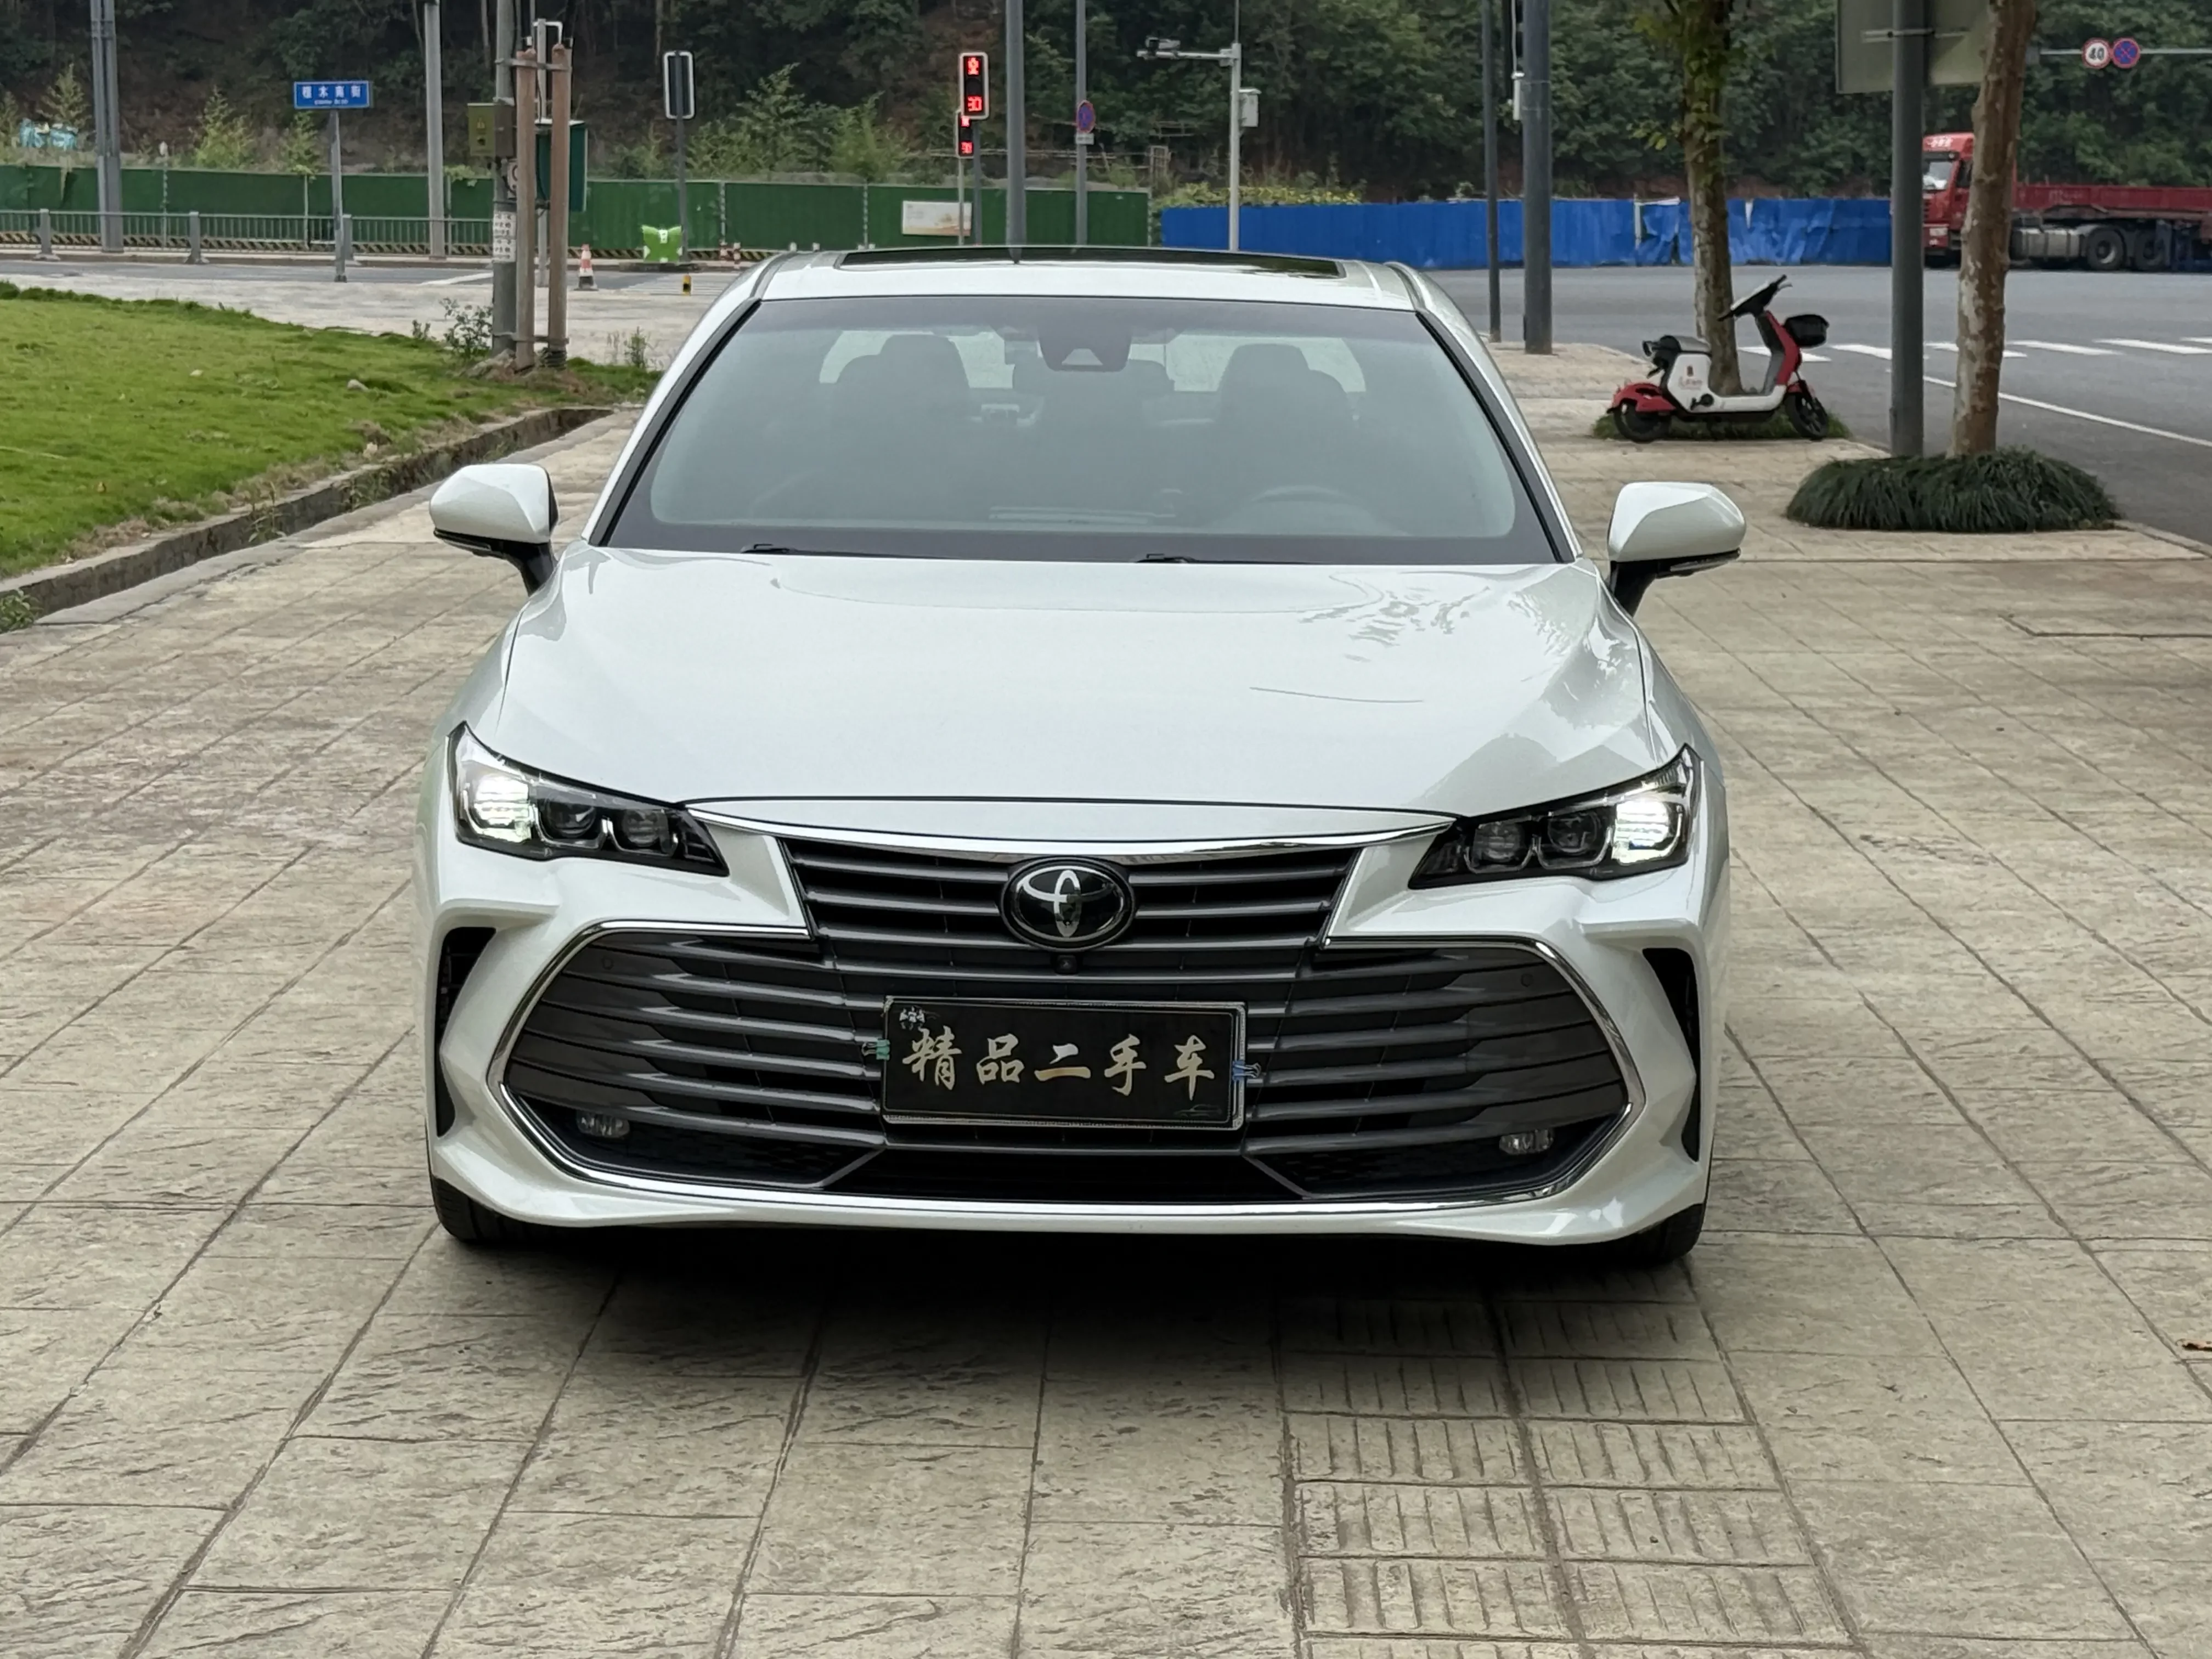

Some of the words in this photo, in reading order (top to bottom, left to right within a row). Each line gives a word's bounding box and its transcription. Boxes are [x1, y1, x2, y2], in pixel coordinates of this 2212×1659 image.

[2089, 48, 2104, 60] 40
[968, 96, 983, 112] 30
[902, 1025, 1215, 1101] 精品二手车
